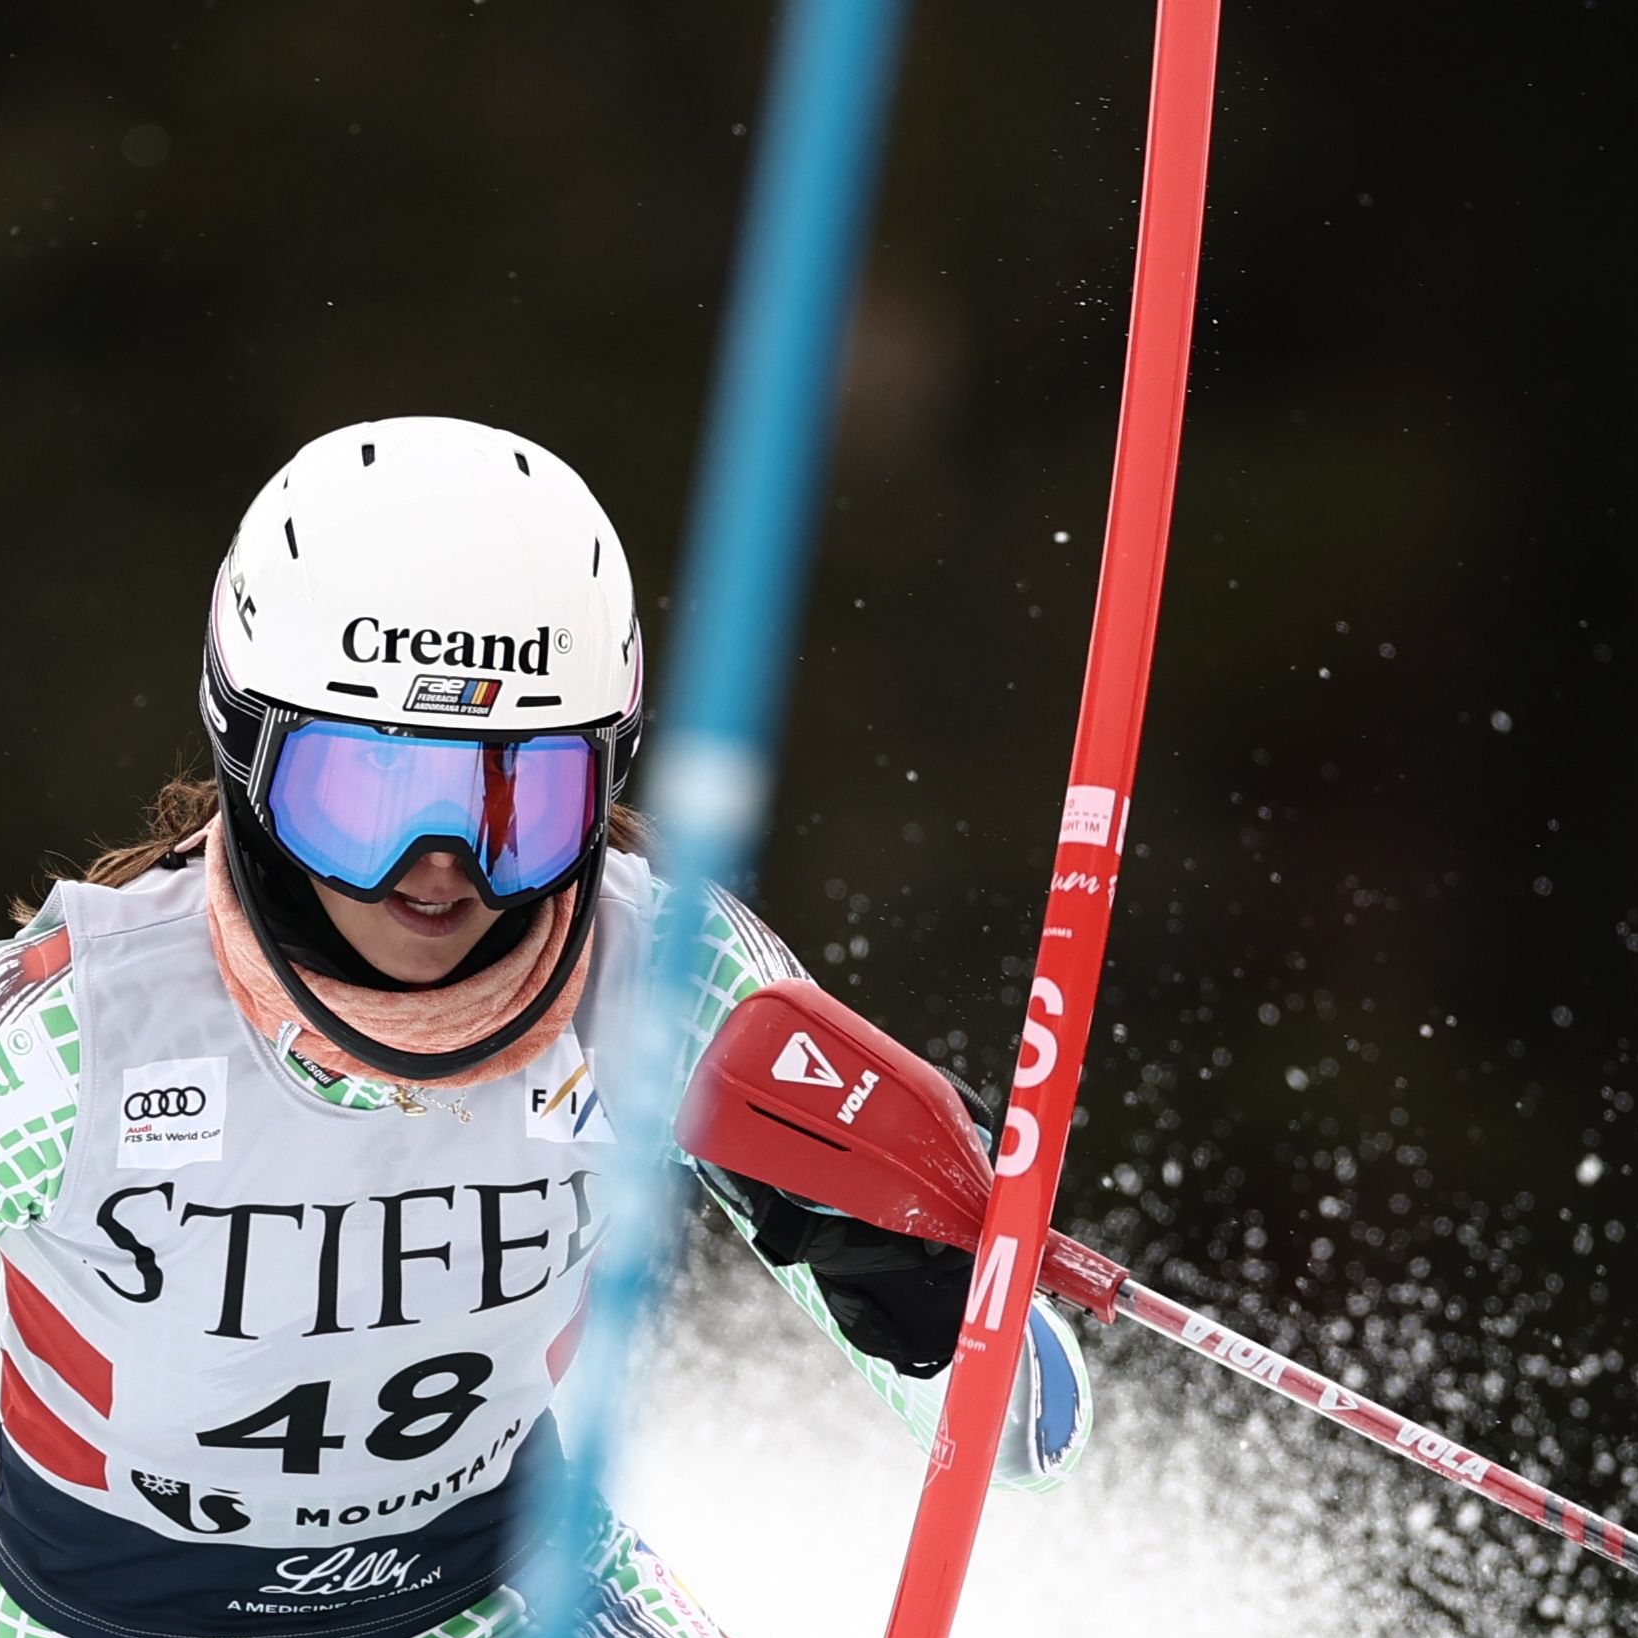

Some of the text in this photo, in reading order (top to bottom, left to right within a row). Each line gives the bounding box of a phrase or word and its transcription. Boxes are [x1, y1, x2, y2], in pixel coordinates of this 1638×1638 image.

[836, 1068, 880, 1125] VOLA
[124, 1128, 222, 1144] FIS Ski World Cup
[126, 1123, 152, 1134] Audi
[1180, 1313, 1288, 1384] VOLA
[195, 1351, 494, 1475] 48
[295, 1418, 525, 1528] MOUNTAIN
[1395, 1420, 1491, 1483] VOLA
[258, 1547, 421, 1595] Lilly
[227, 1600, 242, 1611] A
